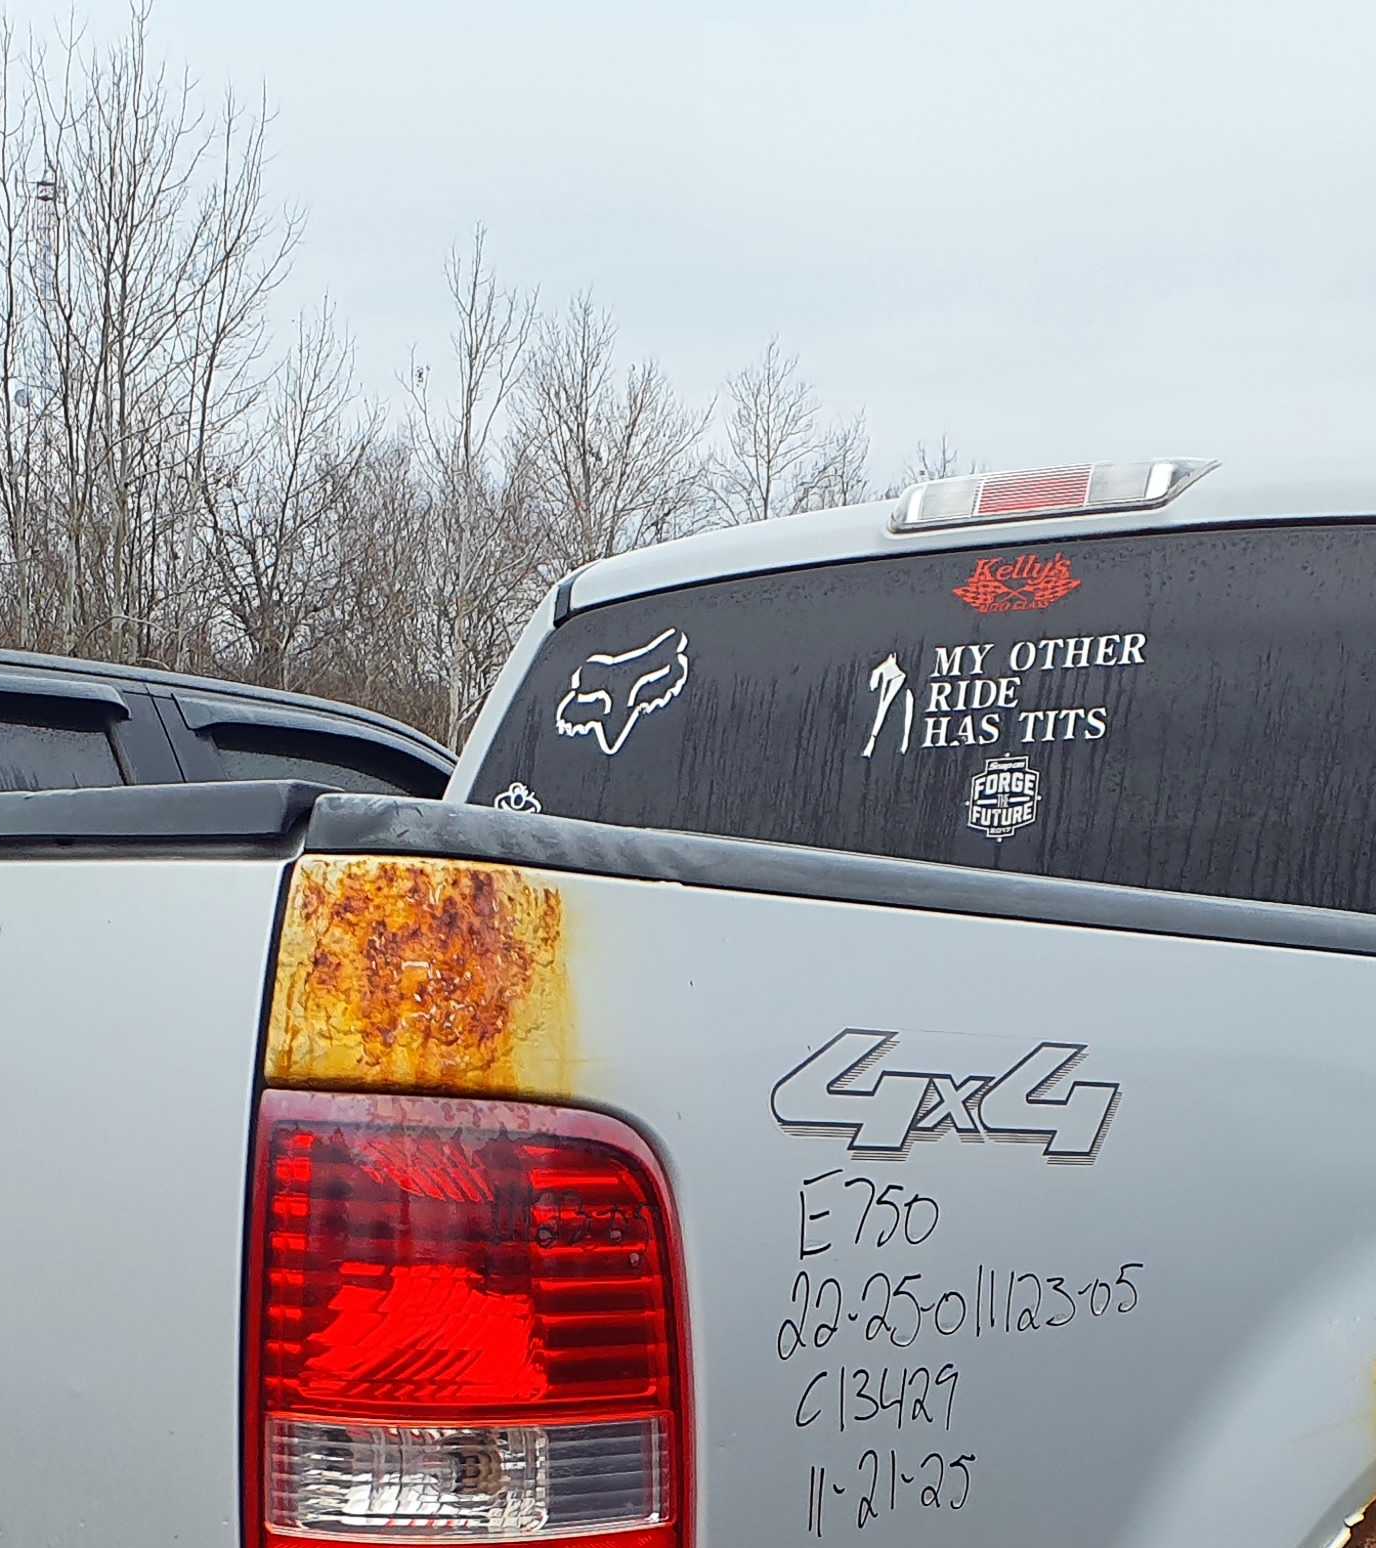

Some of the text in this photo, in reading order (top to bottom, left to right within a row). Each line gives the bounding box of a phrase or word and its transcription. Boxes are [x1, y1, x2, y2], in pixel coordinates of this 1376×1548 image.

[974, 552, 1072, 585] Kelly's
[930, 633, 1146, 677] MY OTHER
[925, 677, 1021, 712] RIDE
[922, 707, 1107, 748] HAS TITS
[974, 772, 1036, 800] FORGE
[972, 801, 1033, 826] FUTURE
[770, 1028, 1122, 1165] 4x4
